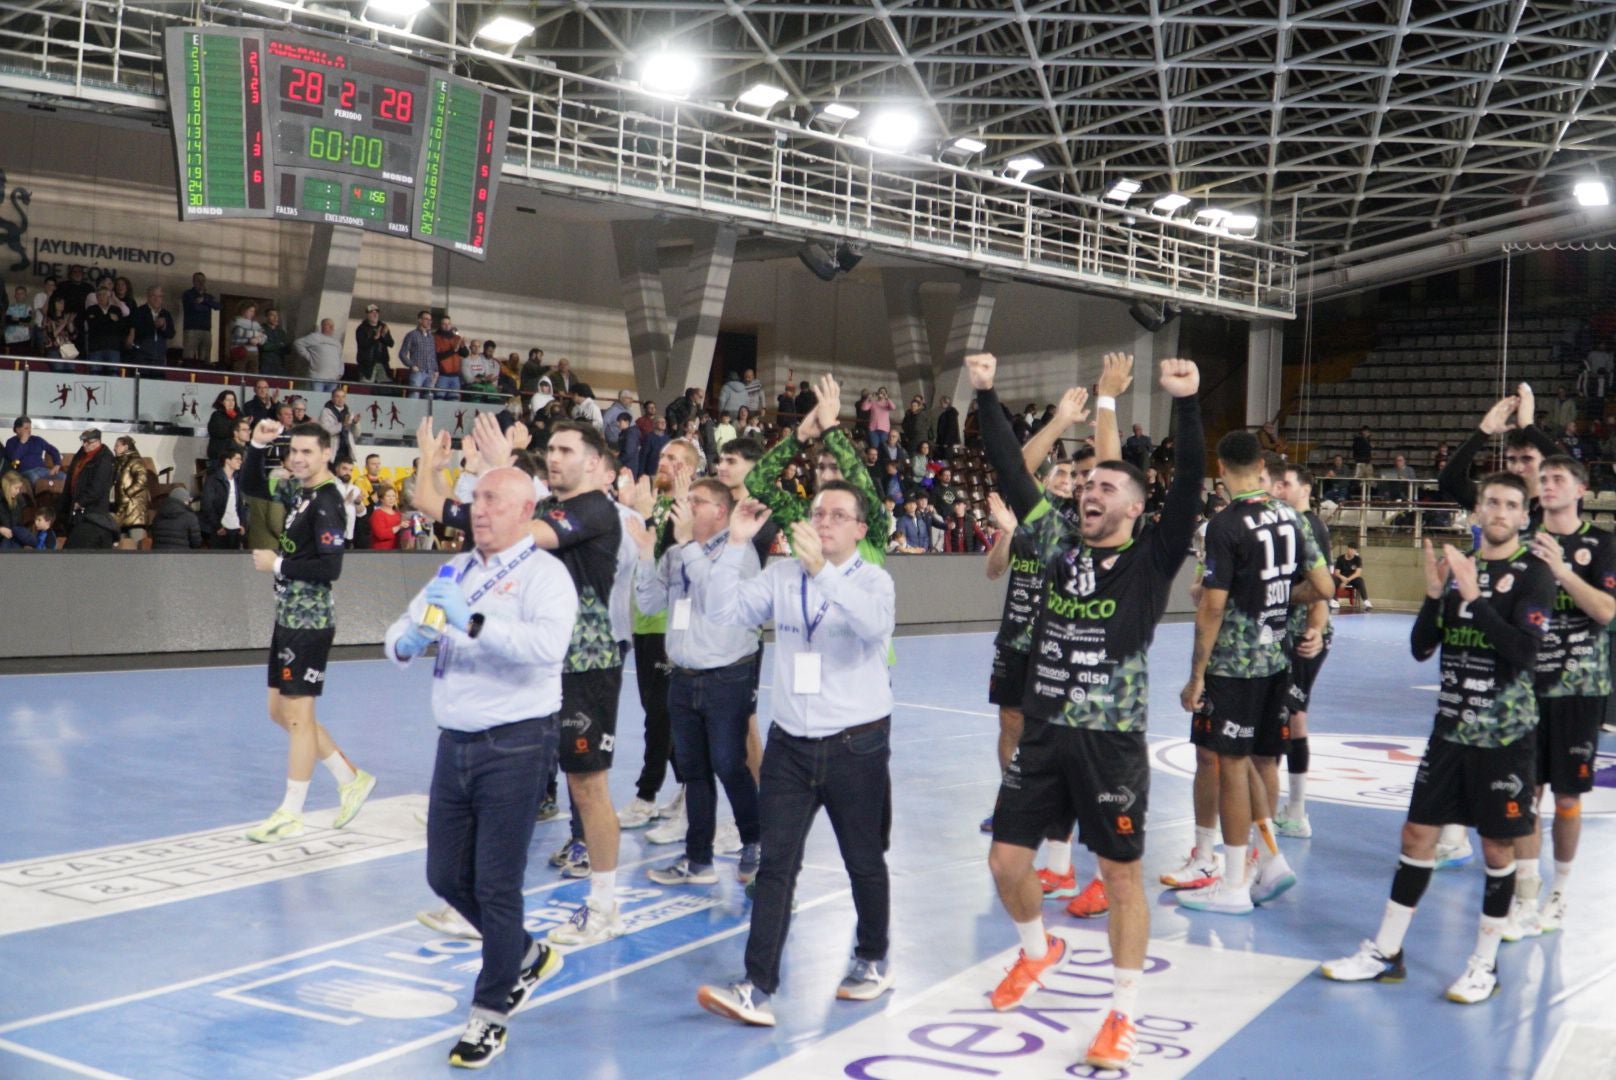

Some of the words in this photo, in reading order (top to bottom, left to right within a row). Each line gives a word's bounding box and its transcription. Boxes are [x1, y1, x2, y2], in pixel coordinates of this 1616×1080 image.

[193, 35, 199, 45] E
[289, 69, 323, 104] 28
[340, 82, 356, 107] 2
[380, 88, 412, 122] 28
[334, 109, 362, 121] PERIODO
[310, 128, 382, 168] 60:00
[382, 172, 413, 183] MONDO
[188, 207, 223, 215] MONDO
[276, 206, 298, 215] FALTAS
[325, 214, 364, 226] EXCLUSIONES
[388, 223, 408, 232] FALTAS
[39, 239, 175, 267] AYUNTAMIENTO
[455, 242, 484, 254] MONDO
[36, 261, 63, 279] DE
[68, 261, 117, 280] ÓN
[1256, 524, 1298, 580] 11
[1078, 672, 1110, 685] alsa
[19, 834, 243, 878] CARRER
[170, 840, 367, 876] TEZZA
